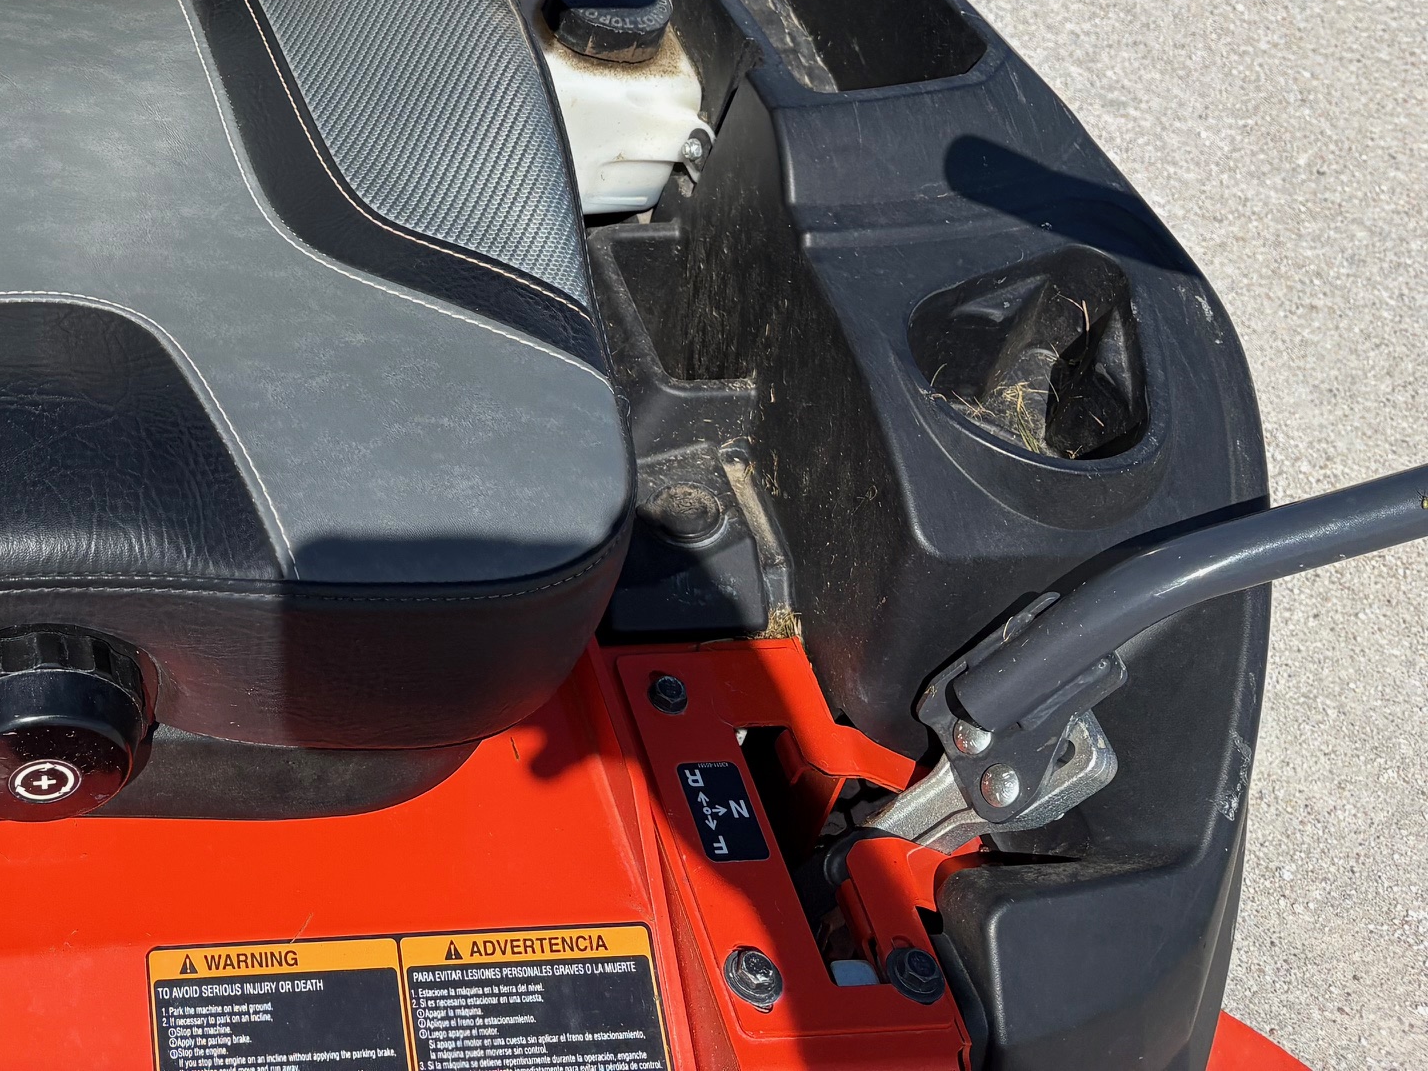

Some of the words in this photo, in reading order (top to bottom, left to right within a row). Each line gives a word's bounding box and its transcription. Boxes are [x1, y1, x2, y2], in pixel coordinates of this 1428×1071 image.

[599, 15, 634, 28] TOP
[684, 769, 704, 787] R
[729, 799, 750, 818] N
[713, 835, 729, 854] F
[469, 934, 609, 958] ADVERTENCIA
[204, 950, 299, 971] WARNING
[413, 971, 434, 983] PARA
[435, 970, 462, 981] EVITAR
[464, 967, 501, 980] LESIONES
[502, 964, 552, 978] PERSONALES
[553, 963, 584, 975] GRAVES
[585, 964, 592, 973] O
[593, 963, 604, 974] LA
[604, 961, 636, 973] MUERTE
[158, 987, 170, 999] TO
[172, 985, 200, 998] AVOID
[202, 983, 241, 997] SERIOUS
[244, 981, 276, 995] INJURY
[279, 981, 292, 993] OR
[295, 979, 324, 992] DEATH
[418, 988, 448, 998] Estacione
[456, 985, 483, 996] máquina
[492, 985, 499, 993] la
[500, 984, 516, 993] tierra
[517, 983, 527, 992] del
[528, 982, 545, 992] nivel.
[161, 1008, 168, 1016] 1.
[169, 1007, 183, 1016] Park
[185, 1006, 194, 1015] the
[196, 1004, 223, 1014] machine
[223, 1005, 232, 1013] on
[233, 1003, 247, 1012] level
[249, 1002, 273, 1013] ground.
[162, 1018, 169, 1027] 2.
[176, 1017, 207, 1027] necessary
[208, 1016, 215, 1024] to
[217, 1014, 230, 1024] park
[232, 1015, 240, 1023] on
[242, 1014, 250, 1022] an
[251, 1012, 273, 1022] incline,
[176, 1028, 191, 1037] Stop
[193, 1026, 202, 1035] the
[204, 1025, 232, 1035] machine.
[177, 1037, 195, 1048] Apply
[196, 1037, 206, 1045] the
[208, 1035, 231, 1046] parking
[232, 1034, 252, 1044] brake.
[185, 1059, 197, 1069] you
[198, 1058, 212, 1068] stop
[214, 1057, 224, 1066] the
[225, 1056, 246, 1066] engine
[247, 1056, 256, 1064] on
[257, 1055, 265, 1063] an
[266, 1053, 287, 1063] incline
[288, 1051, 312, 1062] without
[313, 1051, 339, 1062] applying
[341, 1049, 351, 1059] the
[352, 1048, 376, 1060] parking
[377, 1047, 396, 1057] brake,
